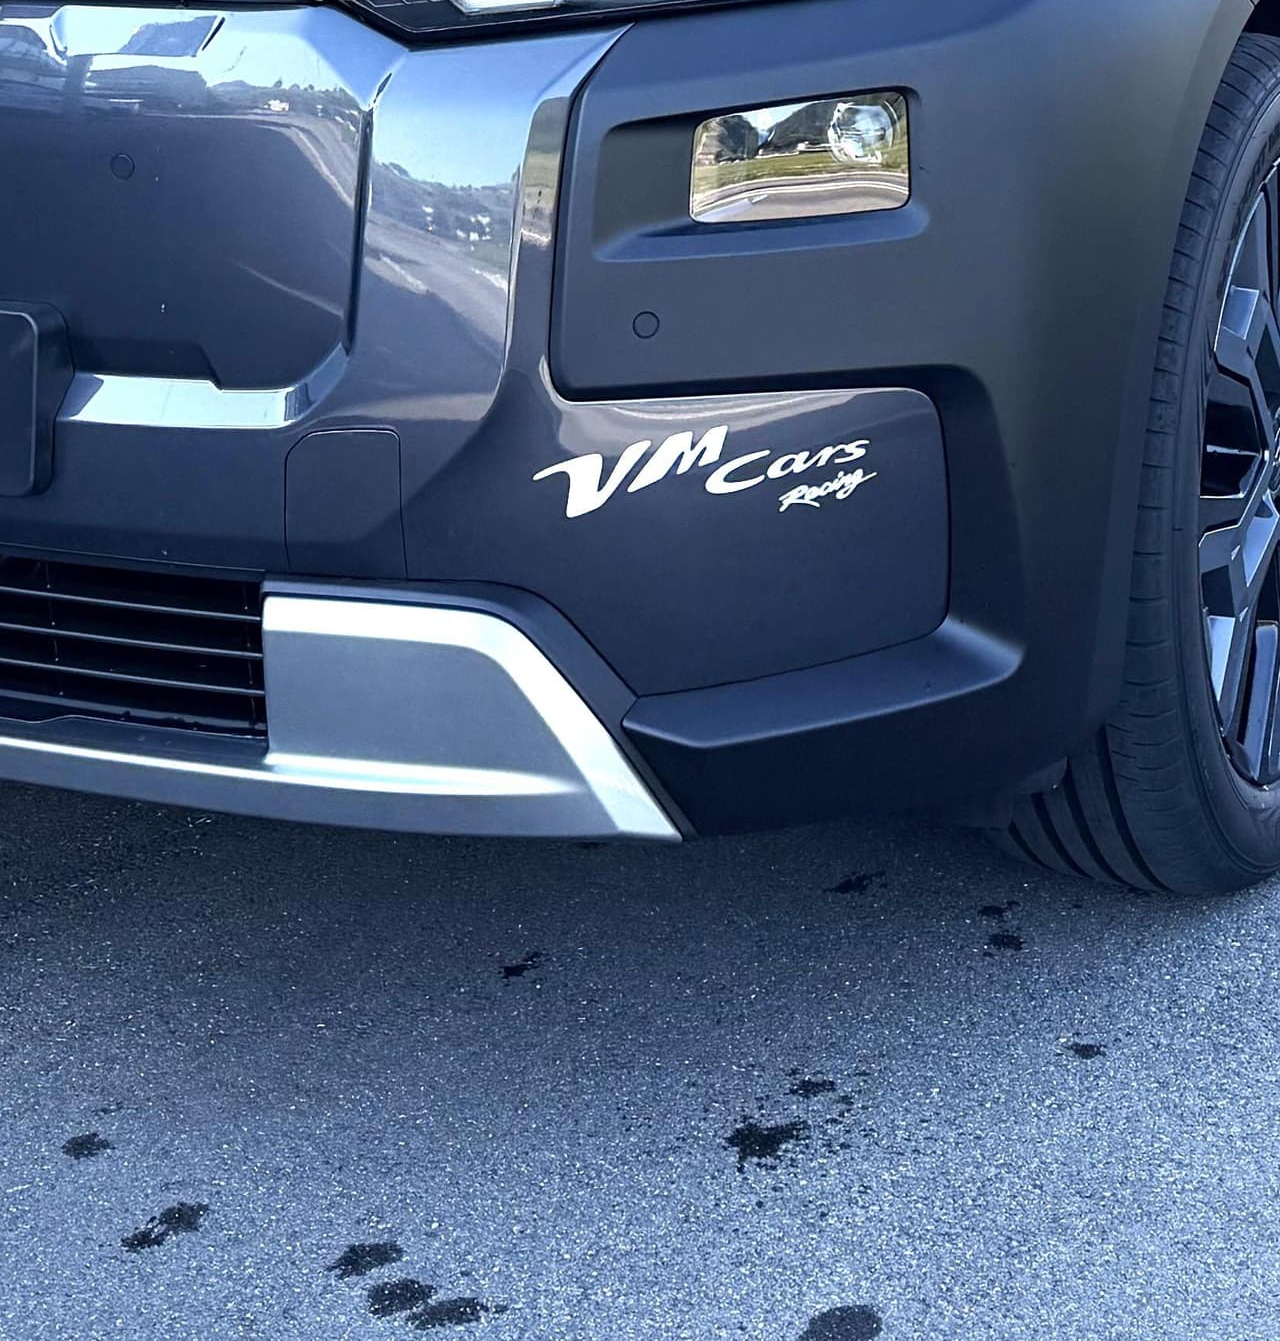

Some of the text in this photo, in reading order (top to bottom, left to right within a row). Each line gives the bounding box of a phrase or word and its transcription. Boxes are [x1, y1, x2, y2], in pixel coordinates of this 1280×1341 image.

[532, 425, 870, 518] VM Cars
[778, 467, 877, 512] Racing
